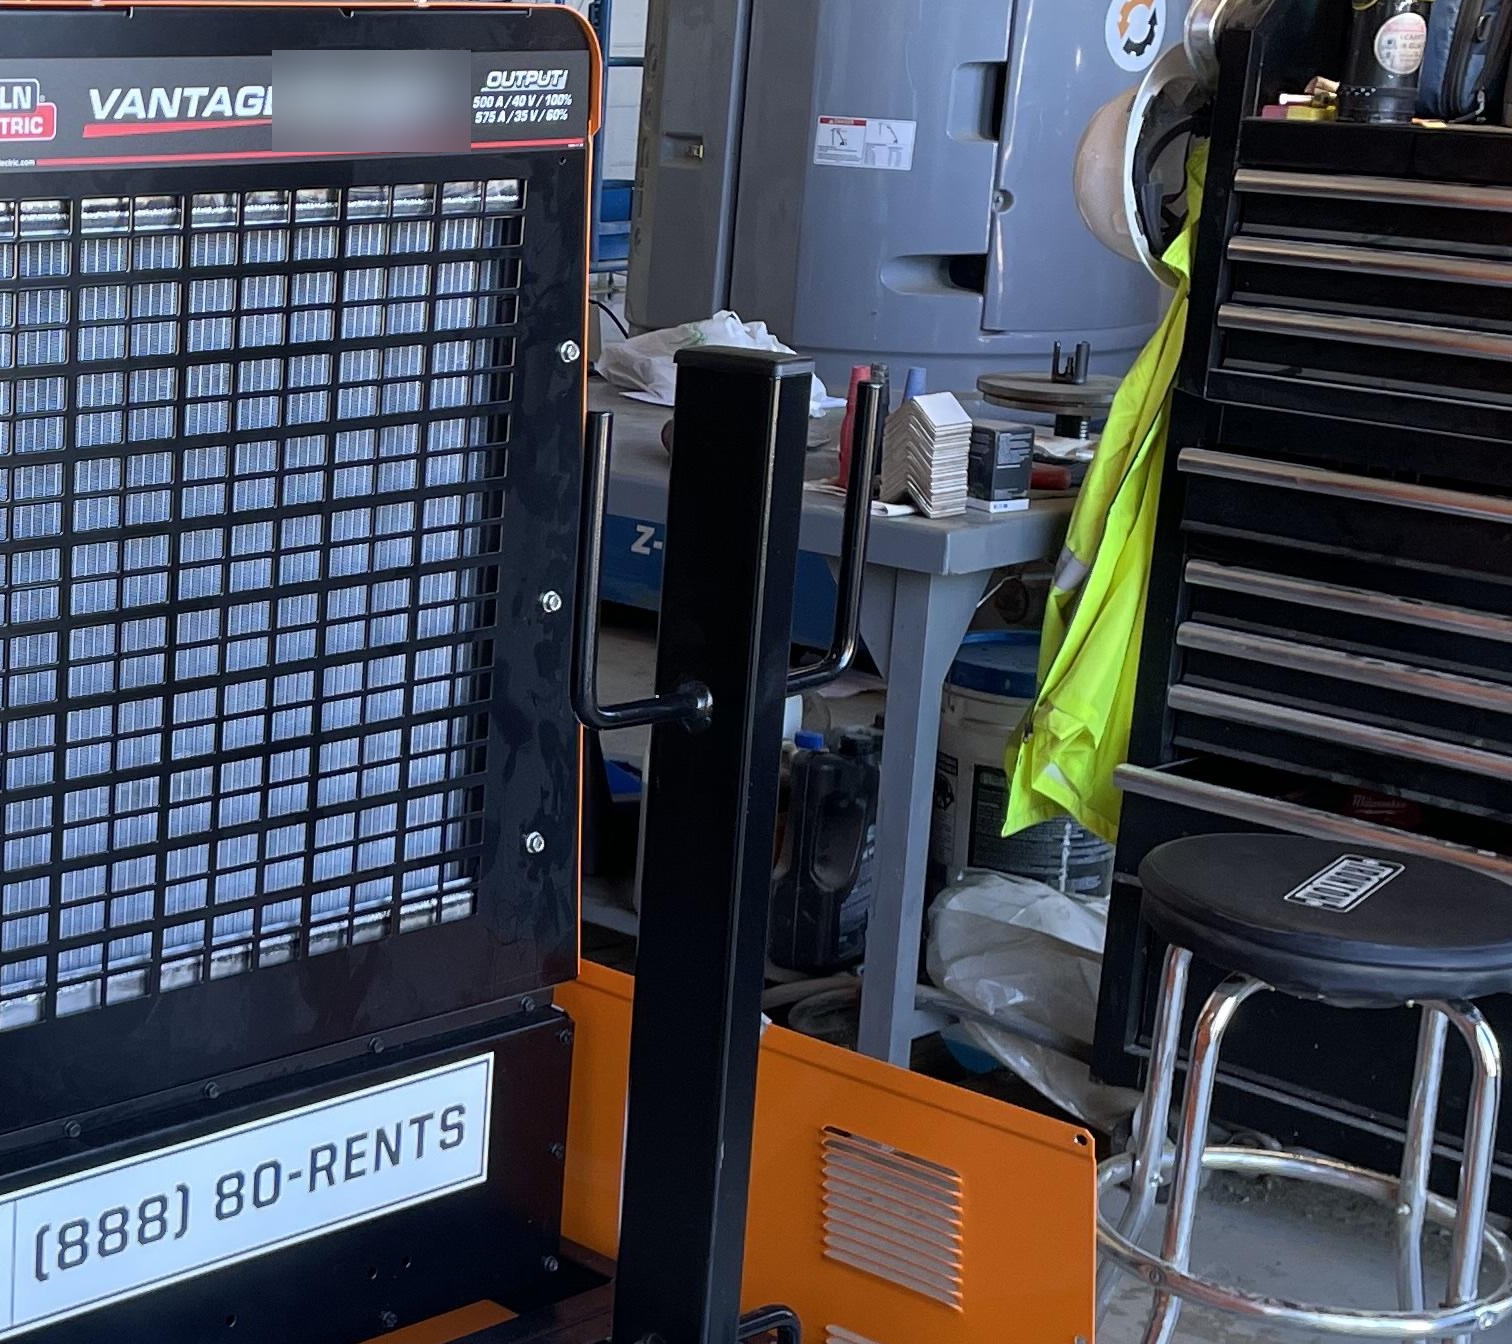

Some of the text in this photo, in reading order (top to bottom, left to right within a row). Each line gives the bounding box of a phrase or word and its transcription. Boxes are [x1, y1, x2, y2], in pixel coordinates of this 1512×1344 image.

[486, 69, 564, 88] OUTPUT
[89, 85, 272, 120] VANTAG
[472, 96, 494, 109] 500
[475, 111, 496, 124] 575
[34, 1104, 467, 1282] (888) 80-RENTS
